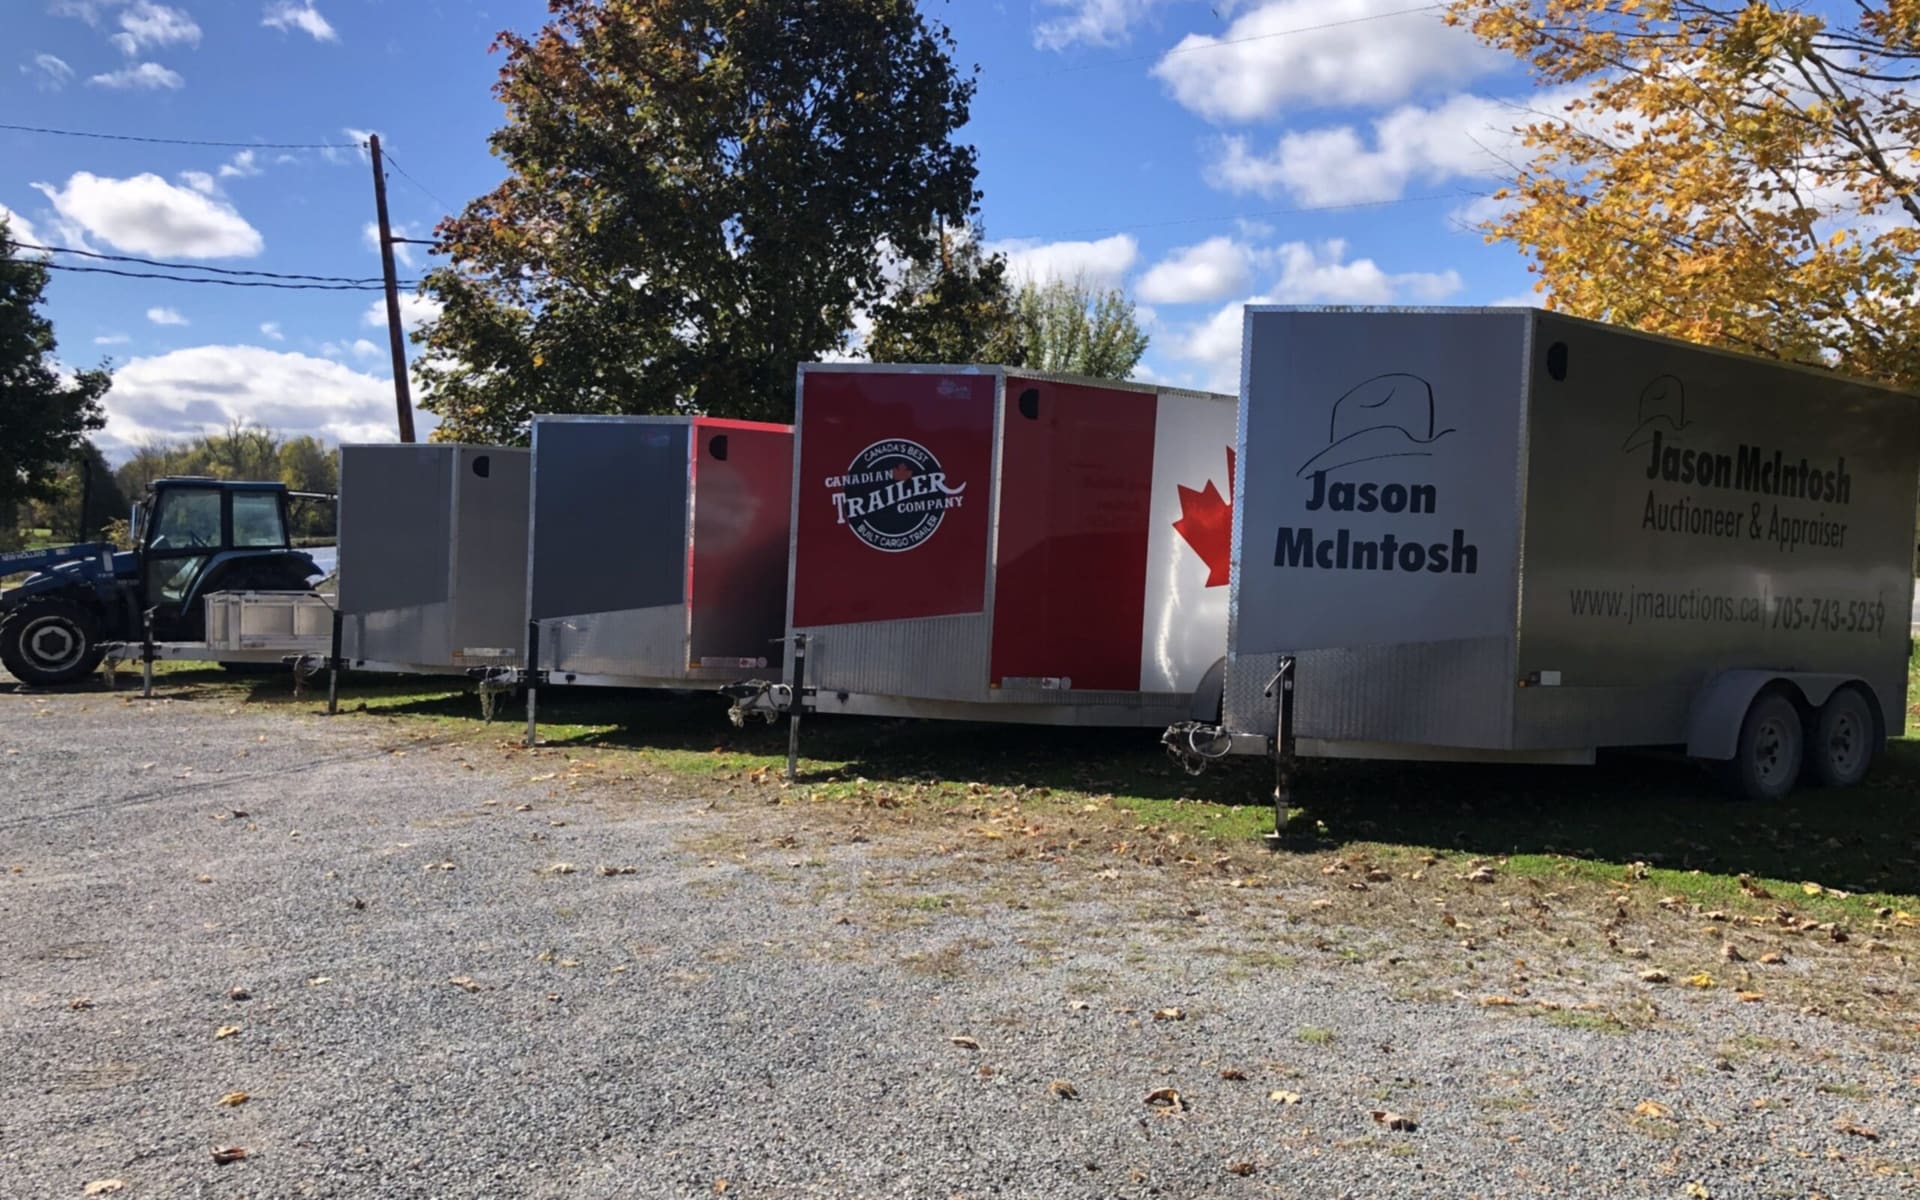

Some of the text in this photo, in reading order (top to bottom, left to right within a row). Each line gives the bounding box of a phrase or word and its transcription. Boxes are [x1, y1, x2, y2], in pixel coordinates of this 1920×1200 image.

[864, 443, 930, 464] CANADA'S BEST
[1647, 430, 1852, 505] Jason McIntosh
[825, 469, 894, 488] CANADIAN
[832, 472, 967, 524] TRAILER
[1305, 471, 1437, 514] Jason
[897, 496, 964, 514] COMPANY
[1642, 491, 1848, 553] Auctioneer & Appraiser
[857, 515, 939, 548] BUILT CARGO TRAILER
[1274, 527, 1479, 574] McIntosh
[1568, 584, 1760, 625] www.jmauctions.ca
